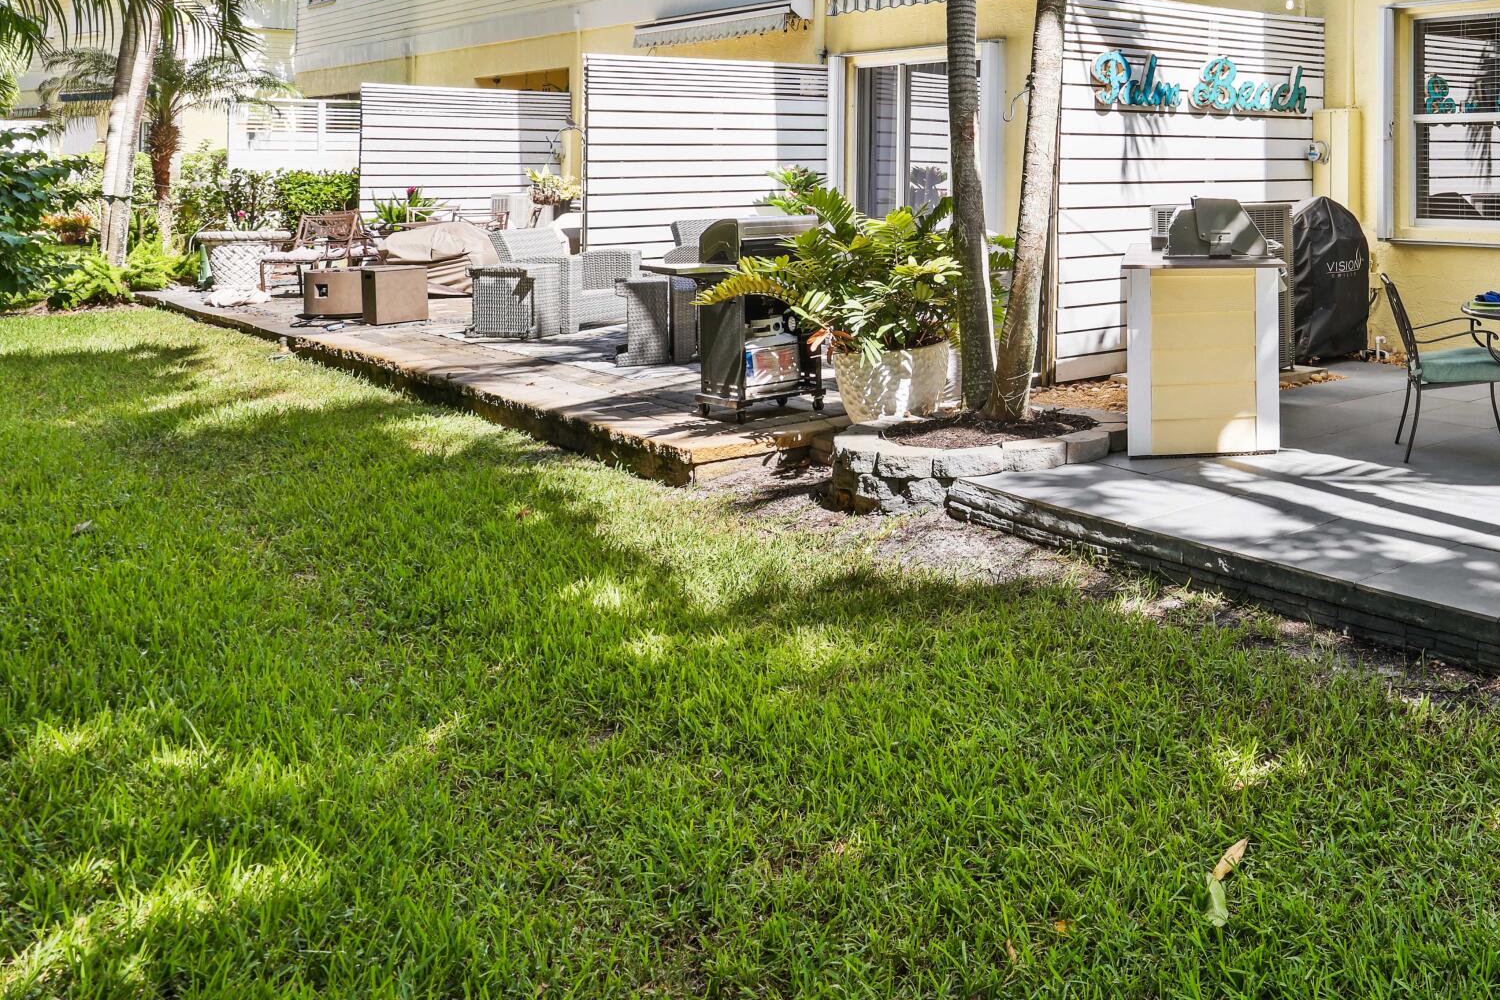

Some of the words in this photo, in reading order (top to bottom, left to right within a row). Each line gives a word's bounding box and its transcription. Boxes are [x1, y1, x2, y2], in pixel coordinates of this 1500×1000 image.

[1091, 49, 1181, 106] Palm
[1188, 55, 1307, 114] Beach
[1326, 255, 1361, 272] VISION
